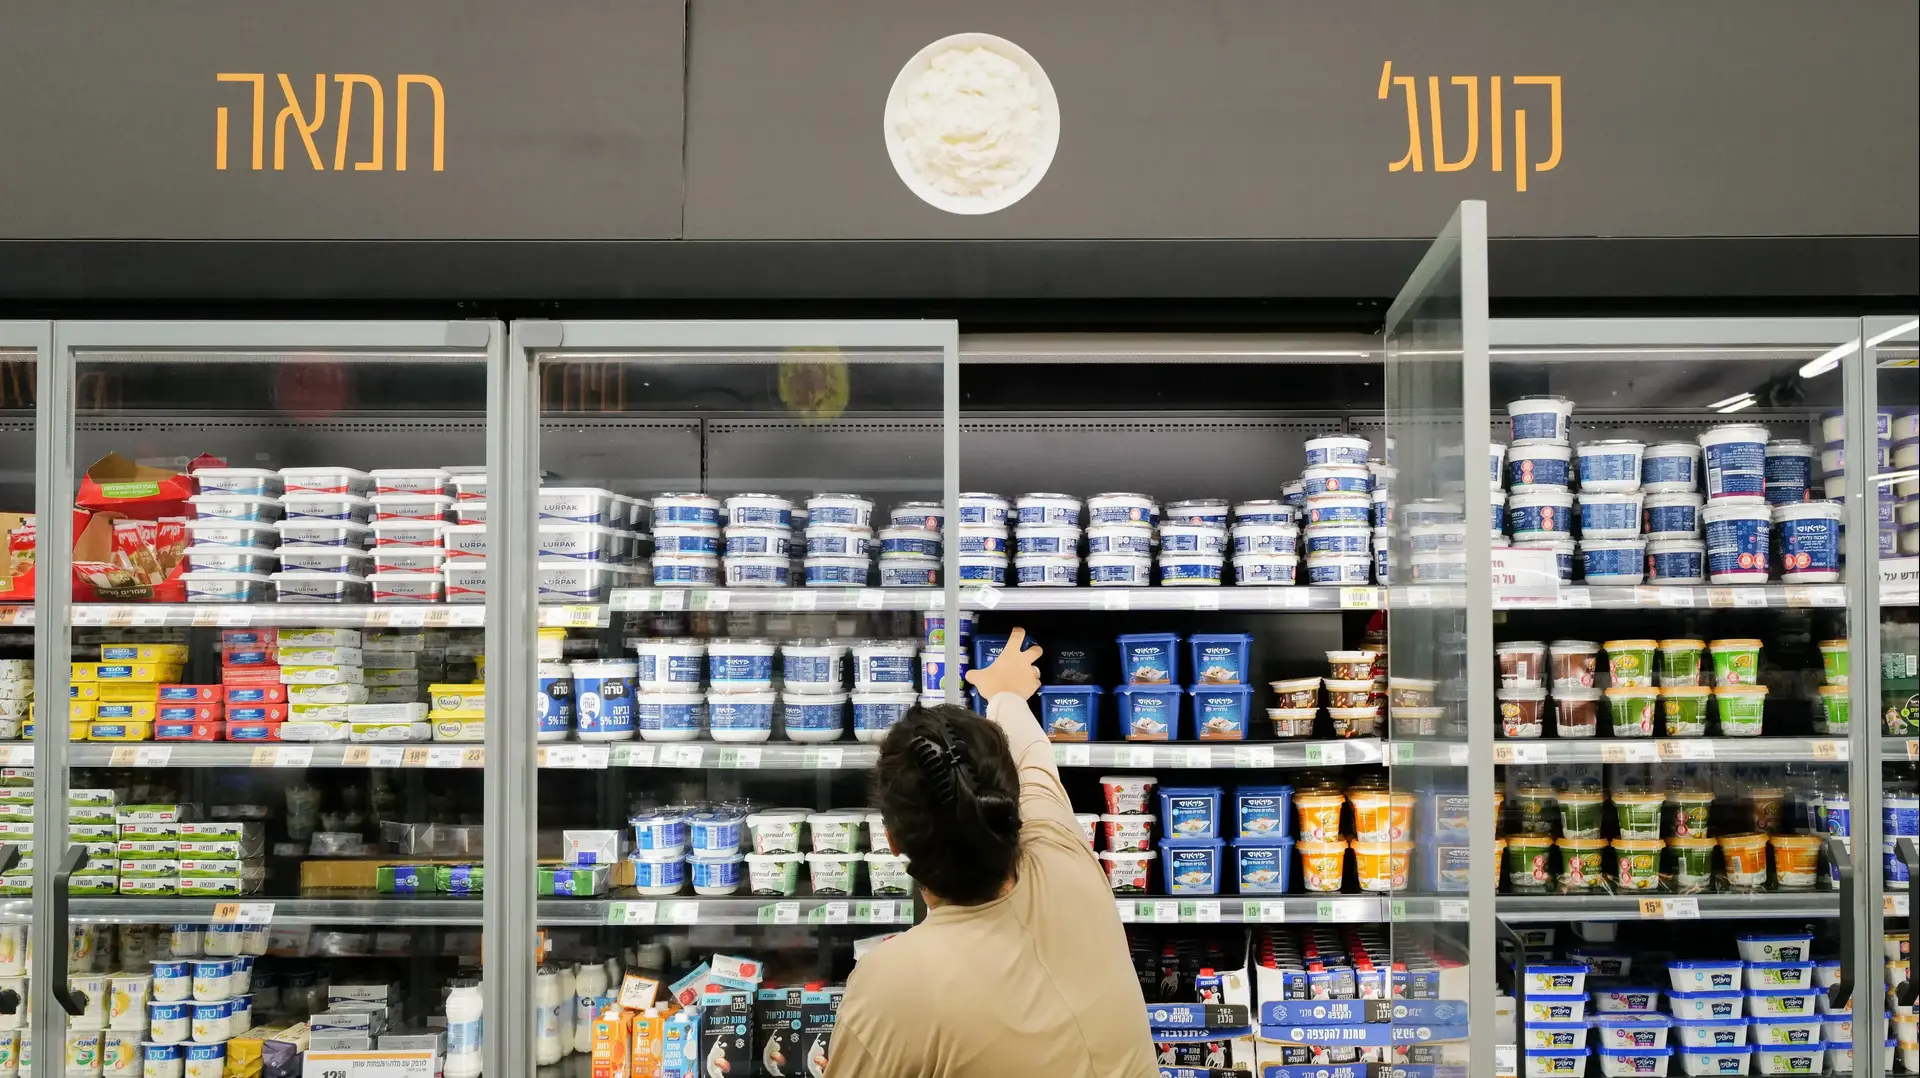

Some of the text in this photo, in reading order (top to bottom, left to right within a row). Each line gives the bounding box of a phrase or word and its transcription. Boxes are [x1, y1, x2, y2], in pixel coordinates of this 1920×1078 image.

[216, 72, 445, 171] חמאה
[1378, 60, 1562, 192] קוטג'
[604, 686, 623, 694] טרה
[613, 706, 630, 715] גבינה
[548, 716, 558, 725] 5%
[600, 716, 630, 725] לבנה 5%
[764, 831, 784, 839] spread
[816, 831, 836, 839] spread
[1119, 830, 1139, 838] spread
[766, 1010, 786, 1019] לבישול
[810, 1014, 828, 1023] לבישול
[1169, 1015, 1193, 1023] להקצפה
[1328, 1011, 1352, 1019] להקצפה
[1376, 1011, 1391, 1019] הלבן
[710, 1016, 730, 1025] לבישול
[1218, 1015, 1233, 1024] הלבן
[1307, 1028, 1366, 1041] שמנת להקצפה
